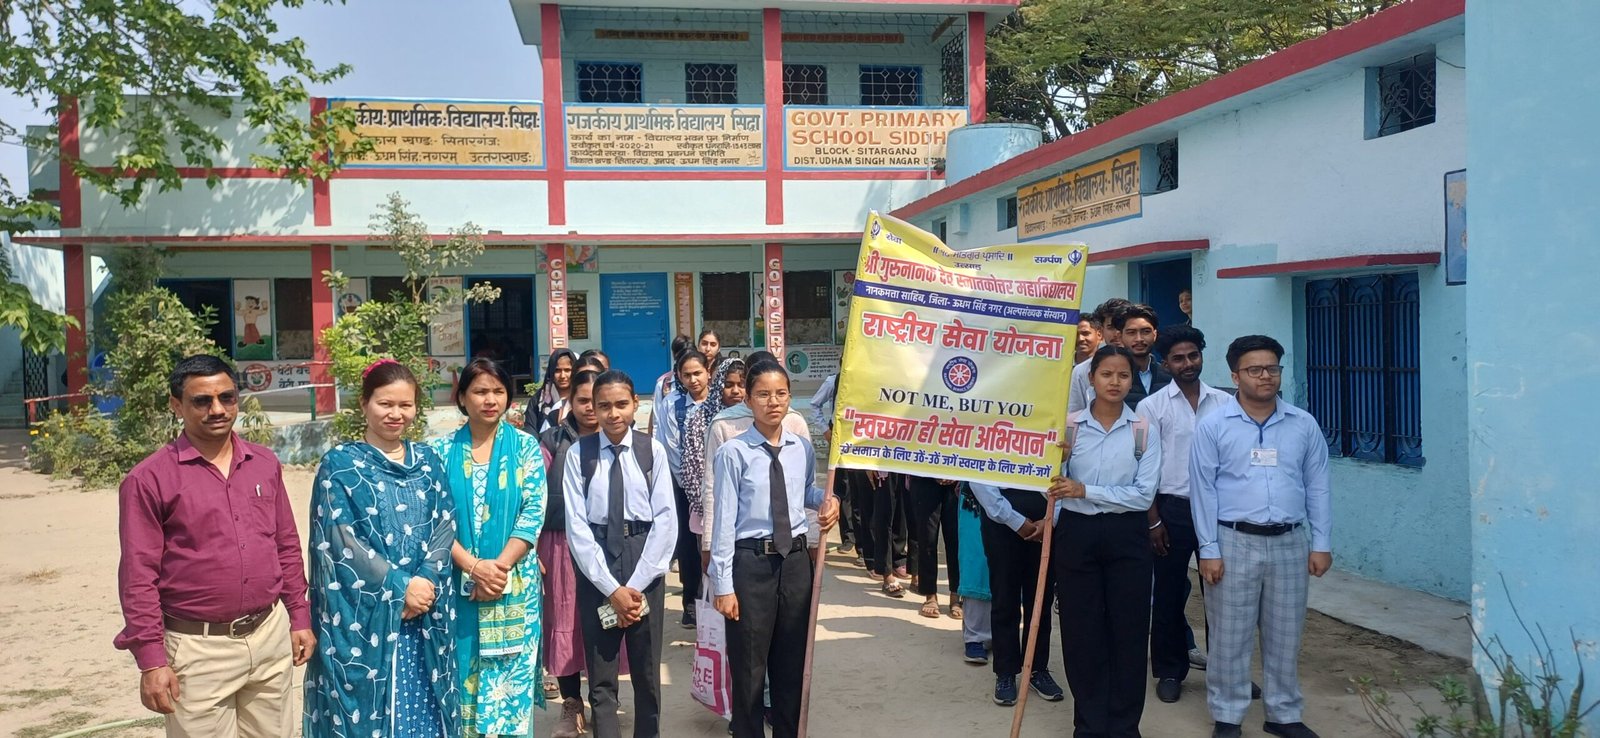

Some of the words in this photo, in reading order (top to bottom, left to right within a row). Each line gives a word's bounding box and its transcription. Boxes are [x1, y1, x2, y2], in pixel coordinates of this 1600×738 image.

[624, 108, 674, 131] प्राथमिक
[675, 108, 725, 131] विद्यालय
[791, 111, 854, 127] GOVT.
[861, 112, 961, 127] PRIMARY
[571, 132, 593, 141] कार्य
[645, 132, 682, 141] विद्यालय
[722, 133, 749, 141] निर्माण
[792, 130, 881, 145] SCHOOL
[889, 131, 946, 145] SIDDH
[633, 149, 664, 157] विद्यालय
[699, 149, 725, 157] समिति
[794, 157, 818, 165] DIST.
[819, 157, 852, 165] UDHAM
[855, 157, 885, 165] SINGH
[890, 157, 920, 165] NAGAR
[815, 147, 849, 156] BLOCK
[857, 147, 917, 156] SITARGANJ
[550, 259, 563, 302] COME
[768, 258, 780, 282] GO
[865, 250, 880, 273] श्री
[1014, 276, 1077, 300] महाविद्यालय
[769, 286, 781, 309] TO
[865, 285, 900, 299] नानकमत्ता
[952, 298, 972, 309] ऊधम
[972, 298, 987, 312] सिंह
[987, 303, 1003, 314] नगर
[551, 304, 564, 326] TO
[770, 312, 782, 364] SERV
[862, 311, 937, 344] राष्ट्रीय
[942, 318, 988, 352] सेवा
[992, 325, 1064, 359] योजना
[879, 387, 919, 404] NOT
[922, 394, 954, 413] ME,
[959, 397, 995, 414] BUT
[997, 402, 1034, 418] YOU
[918, 415, 939, 443] ही
[938, 417, 974, 447] सेवा
[852, 444, 881, 457] समाज
[882, 446, 892, 459] के
[893, 447, 912, 461] लिए
[942, 453, 959, 467] जगें
[987, 458, 997, 471] के
[998, 459, 1017, 474] लिए
